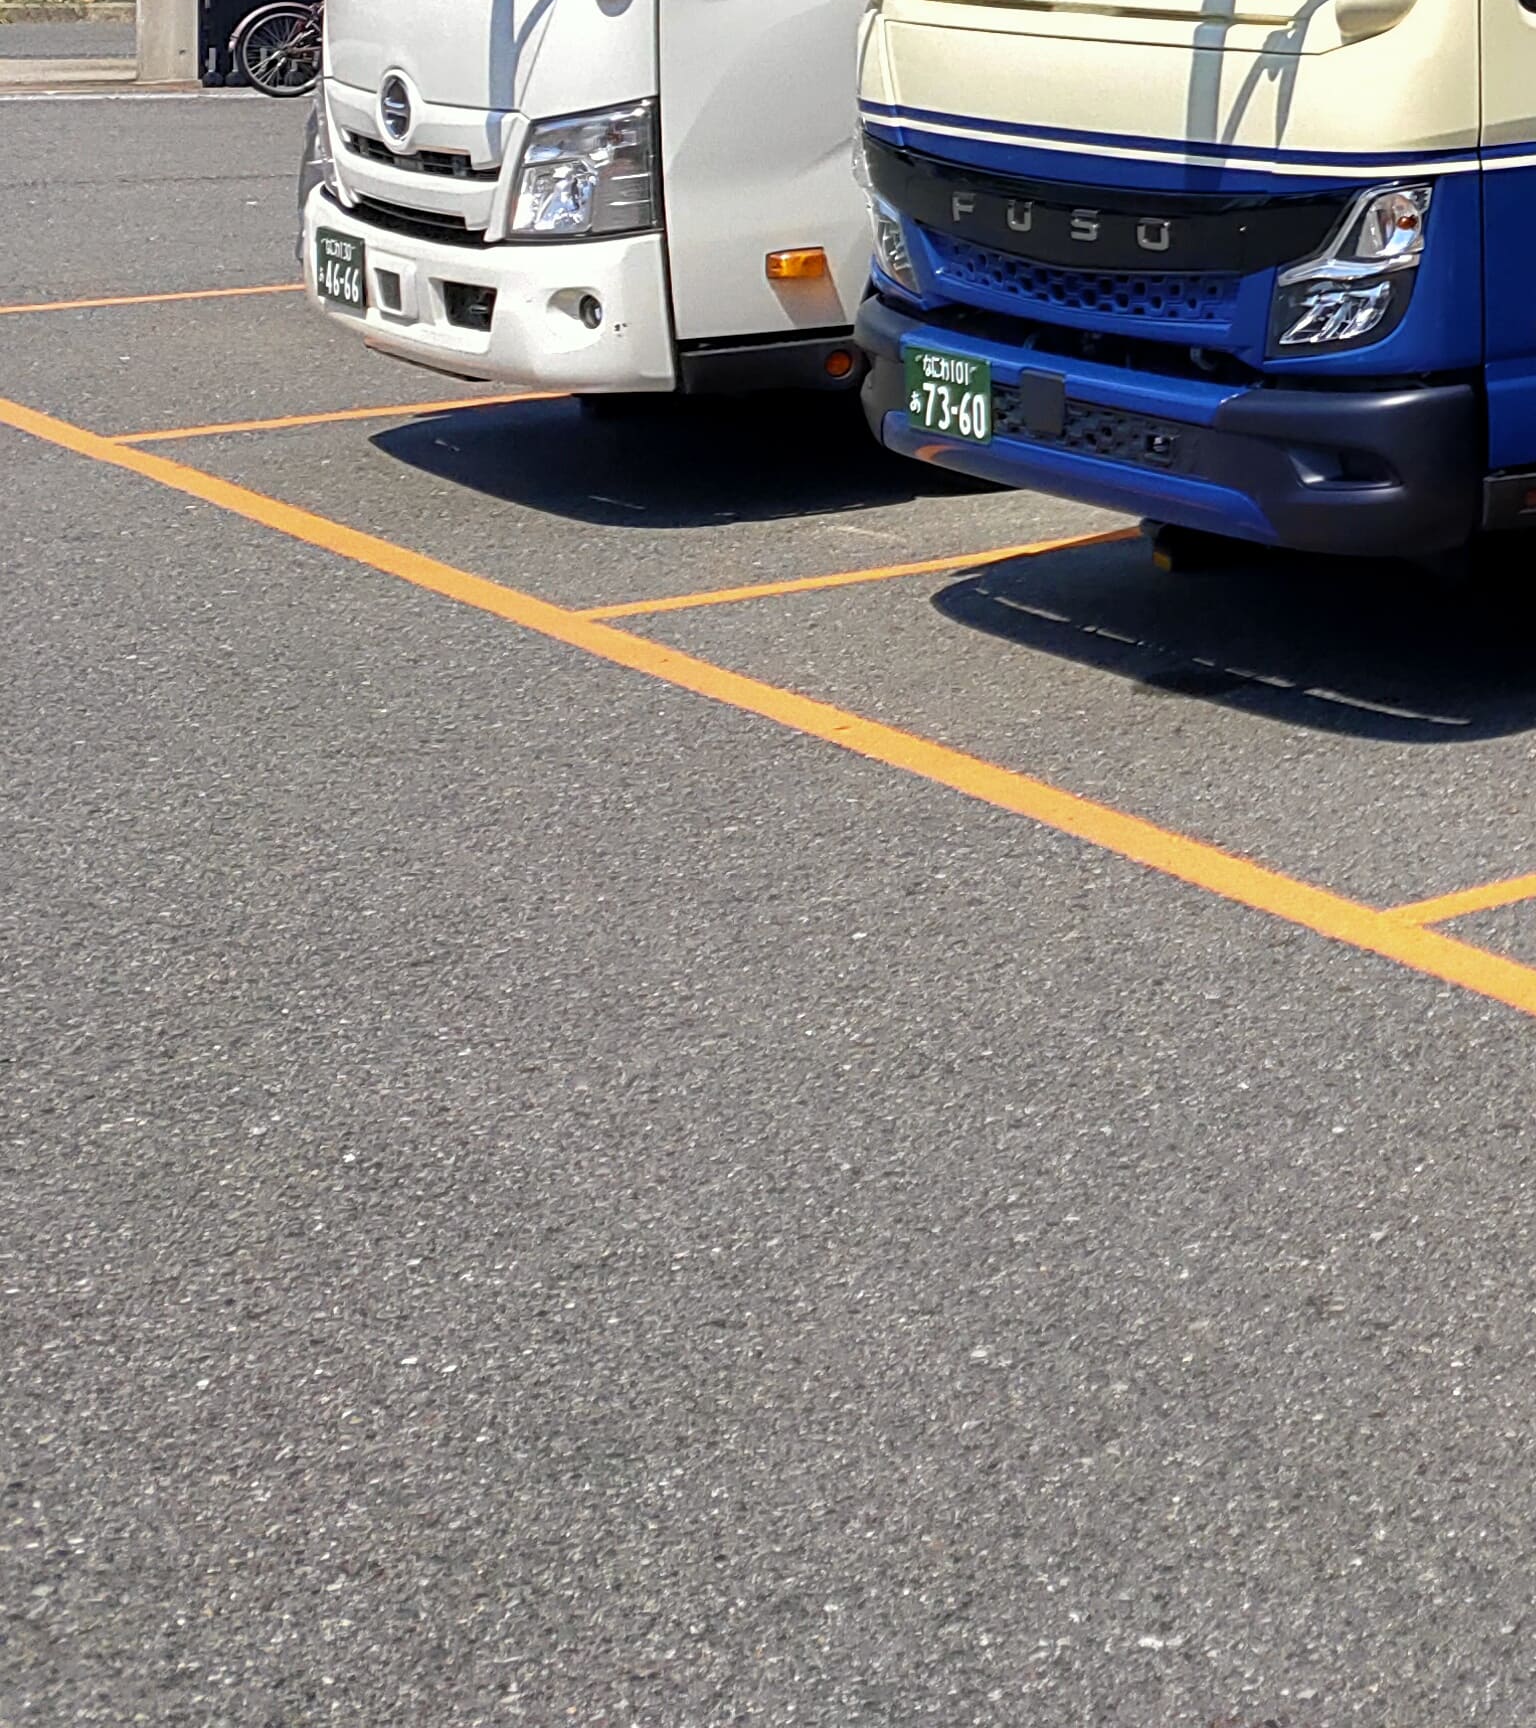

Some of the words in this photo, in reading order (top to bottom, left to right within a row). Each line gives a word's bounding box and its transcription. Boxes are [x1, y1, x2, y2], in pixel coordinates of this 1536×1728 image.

[952, 191, 1170, 251] FUSO
[325, 259, 360, 303] 46-66
[909, 391, 921, 413] あ
[923, 382, 986, 439] 73-60
